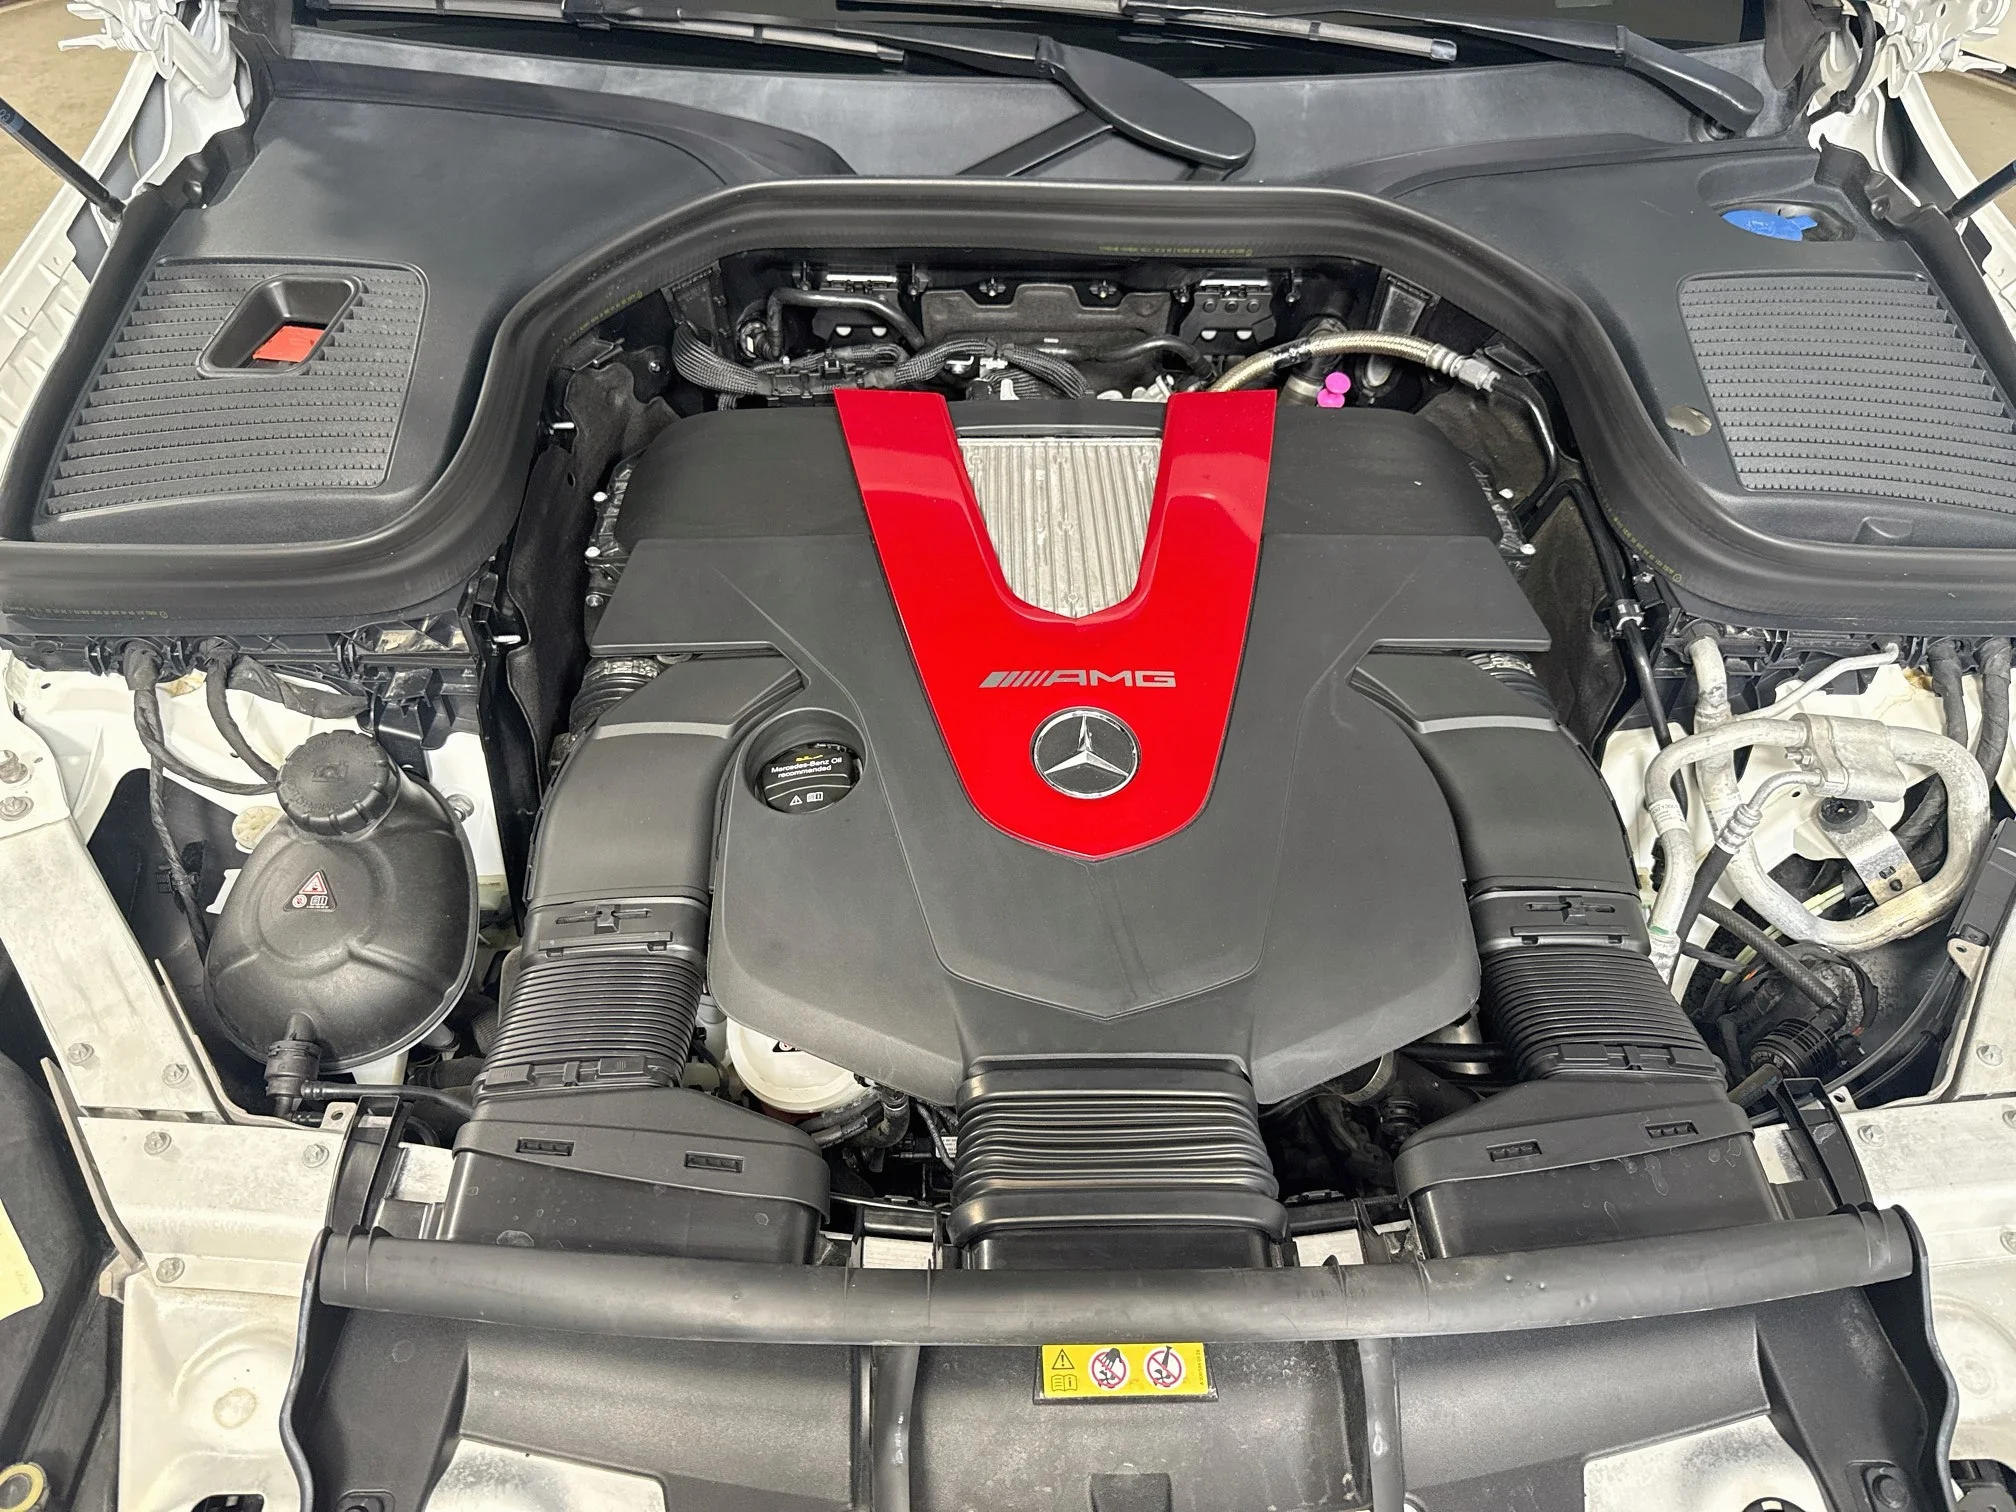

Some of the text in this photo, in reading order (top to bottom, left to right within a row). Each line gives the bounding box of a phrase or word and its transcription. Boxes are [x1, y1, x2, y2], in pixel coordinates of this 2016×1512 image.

[1042, 669, 1177, 688] AMG
[771, 759, 830, 773] Mercedes-Benz
[778, 765, 832, 778] recommended
